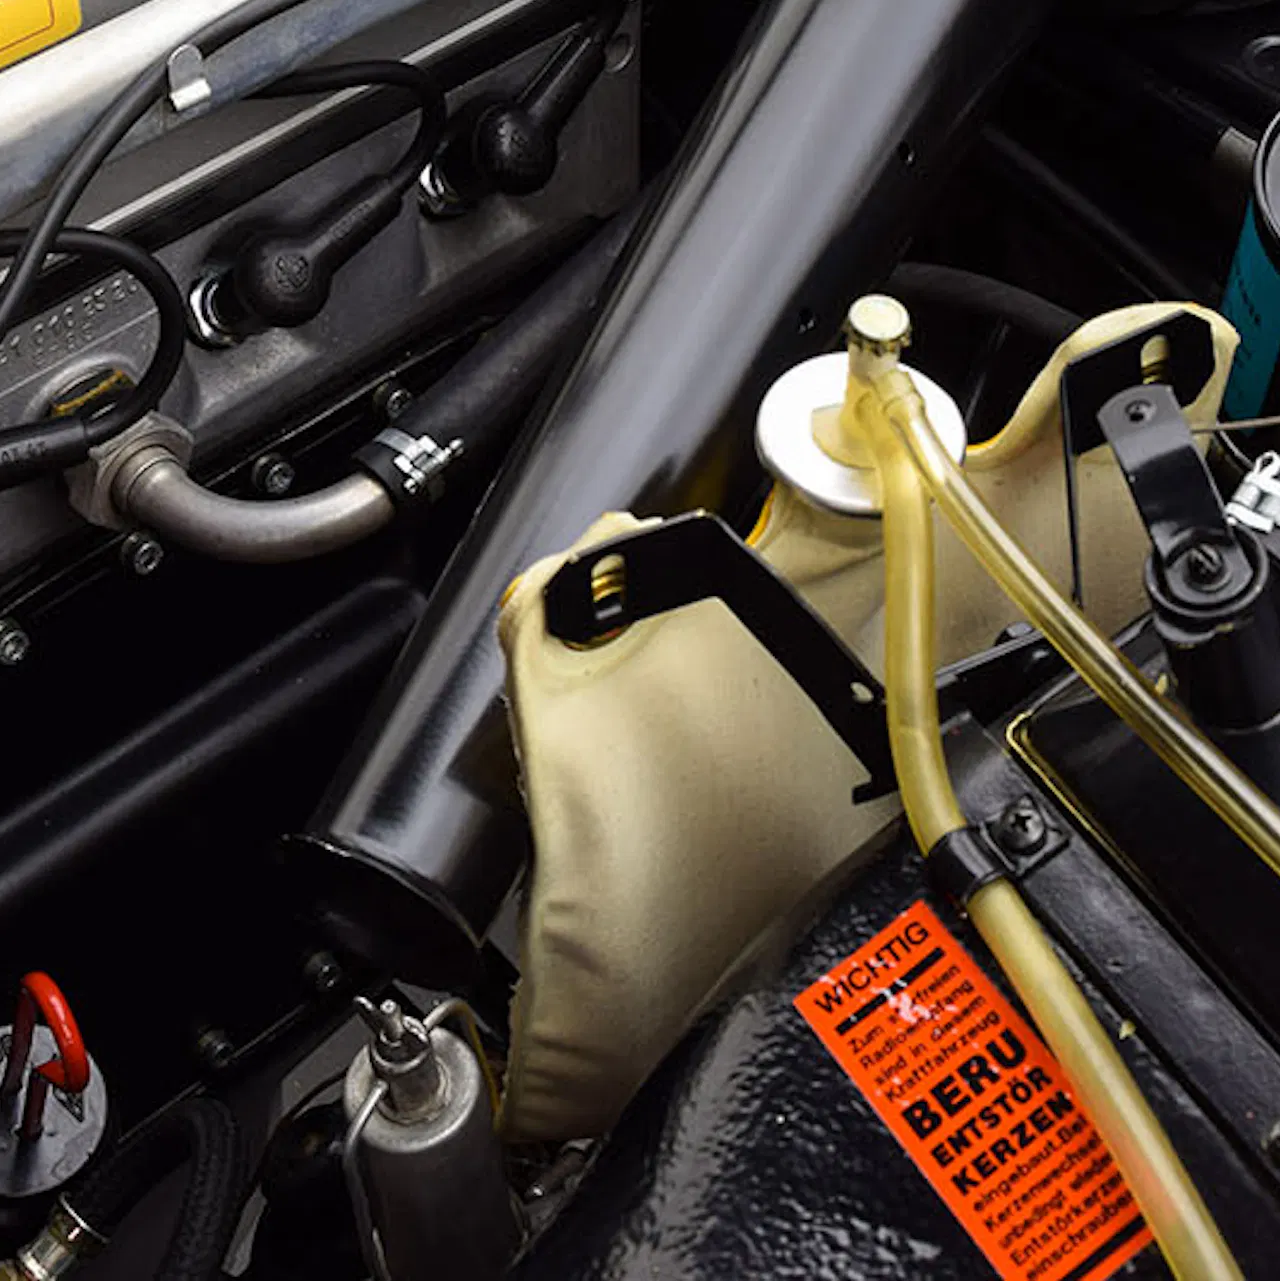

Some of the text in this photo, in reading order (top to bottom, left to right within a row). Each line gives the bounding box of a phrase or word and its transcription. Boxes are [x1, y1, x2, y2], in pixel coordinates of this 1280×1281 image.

[814, 921, 930, 1014] WICHTIG
[847, 965, 962, 1054] Zum srfreien
[875, 995, 987, 1085] sind in diesem
[885, 1010, 1001, 1103] Kraftfahrzeug
[901, 1028, 1028, 1140] BERU
[931, 1067, 1052, 1169] ENTSTÖR
[951, 1089, 1075, 1197] KERZEN
